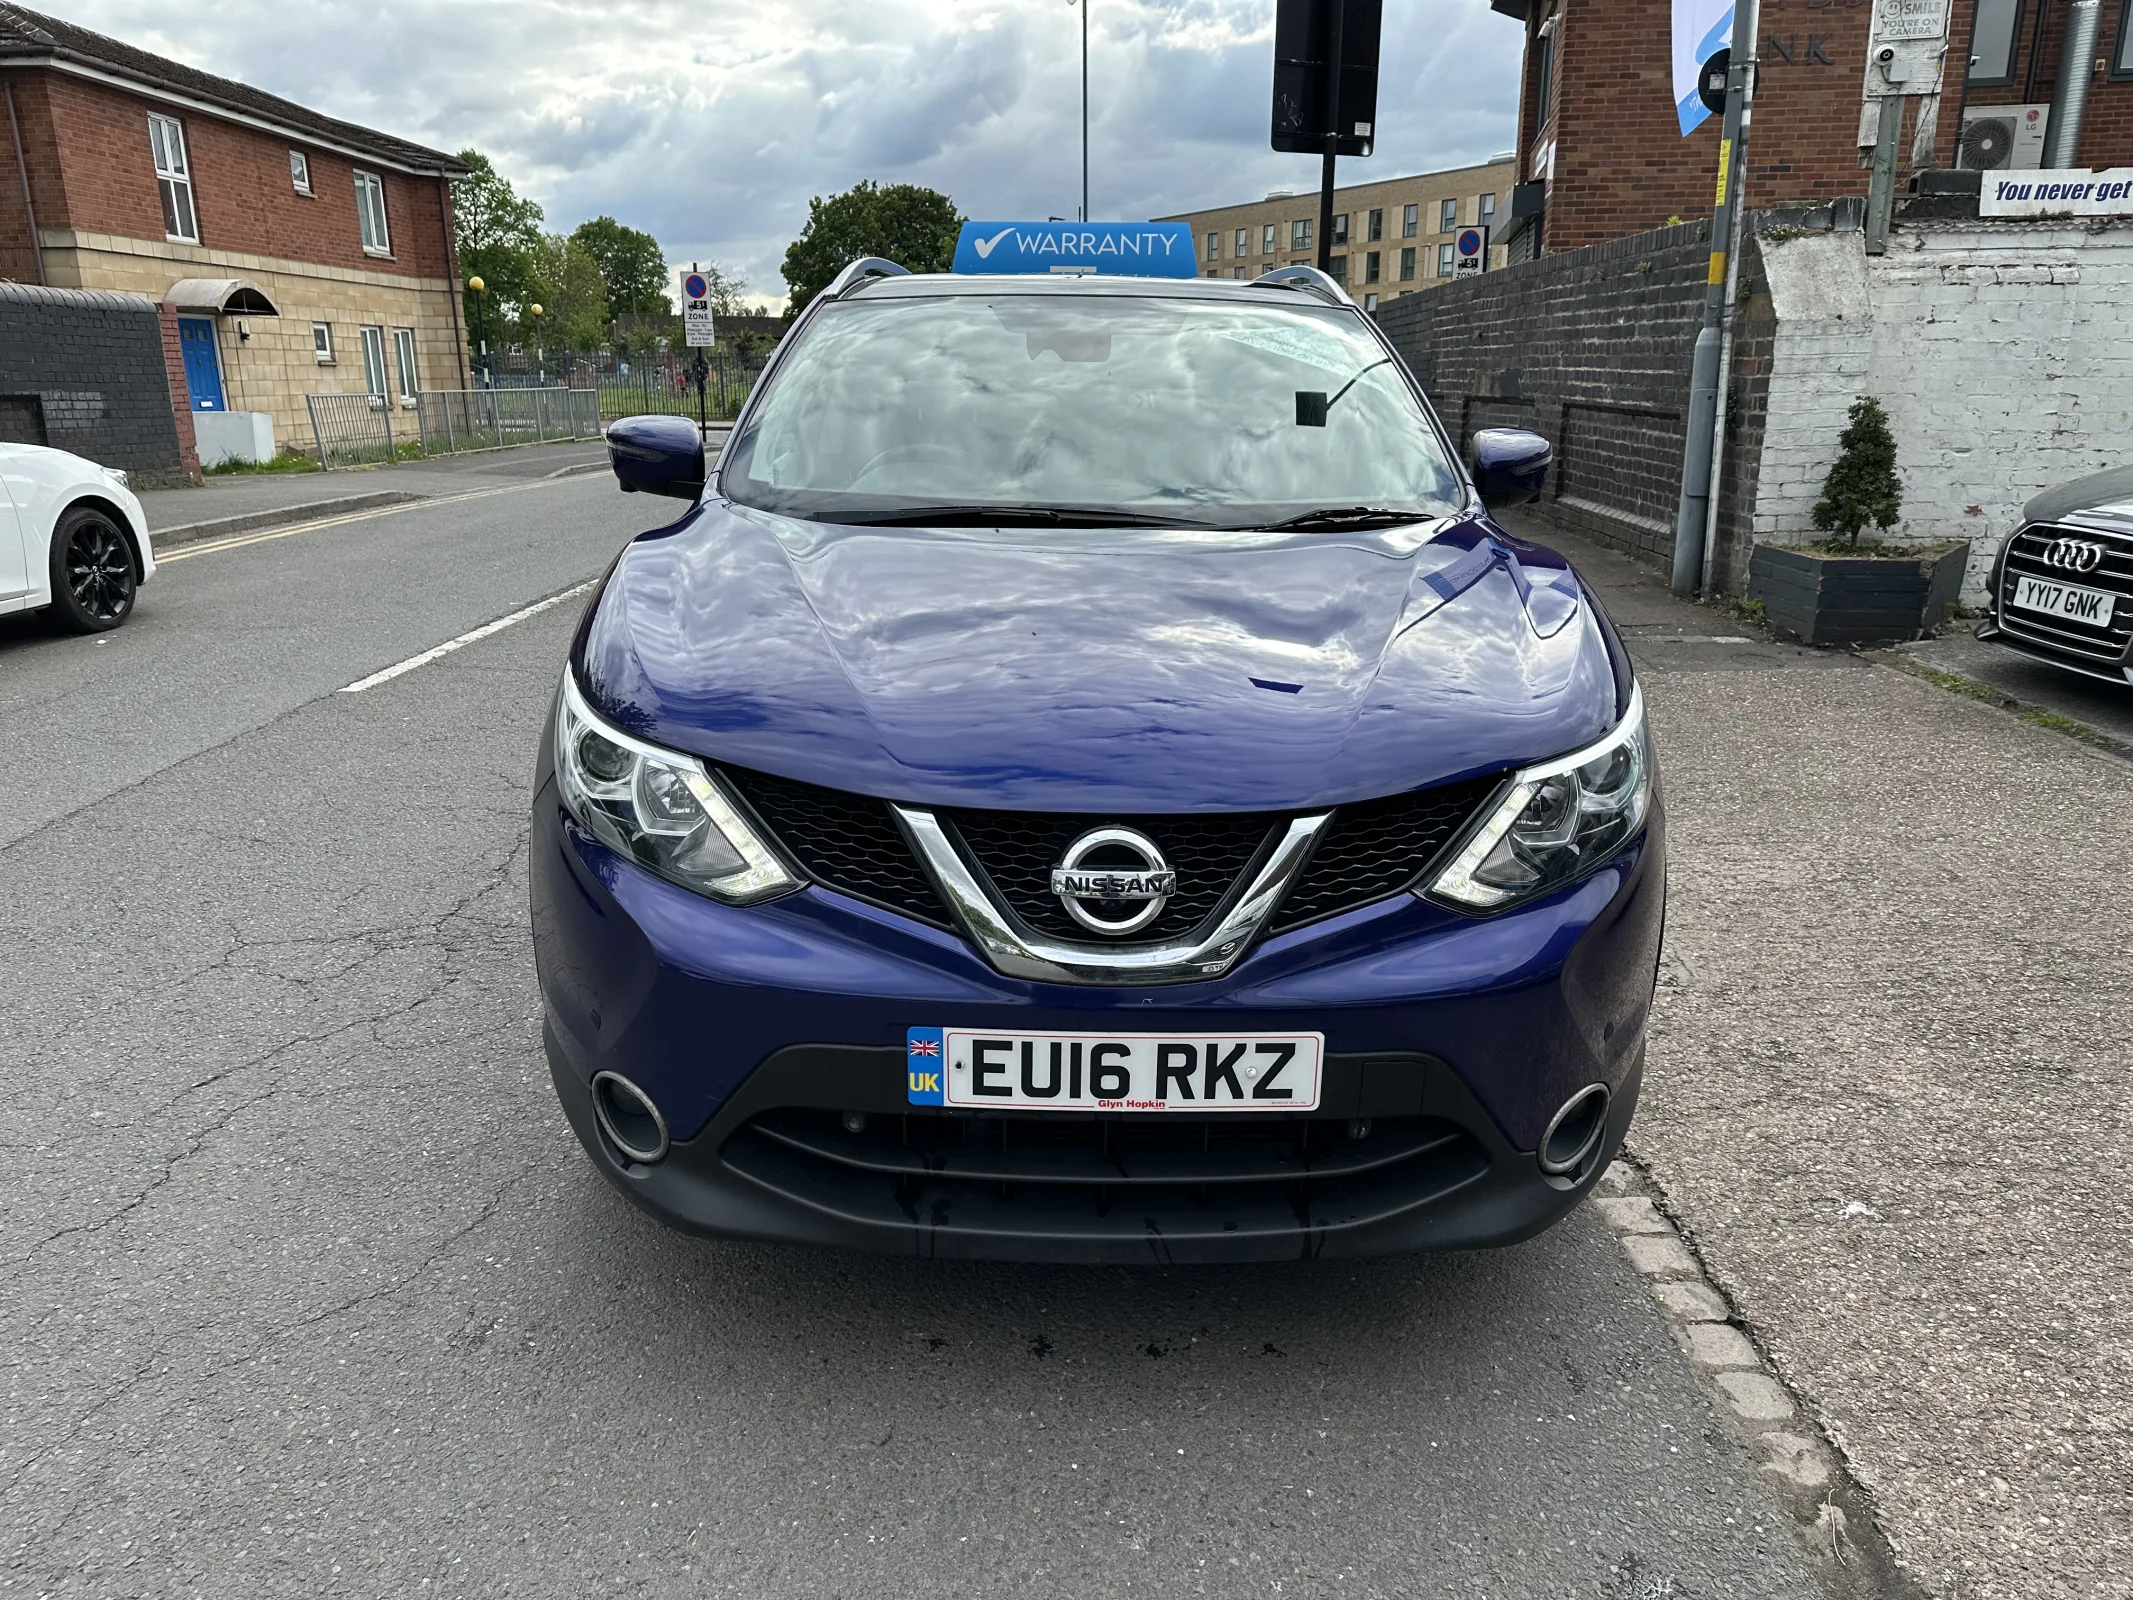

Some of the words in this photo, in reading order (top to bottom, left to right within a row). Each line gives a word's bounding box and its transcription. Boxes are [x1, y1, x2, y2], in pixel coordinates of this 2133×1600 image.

[1904, 2, 1941, 15] SMILE
[1882, 18, 1920, 28] YOU'RE
[1923, 17, 1940, 26] ON
[1889, 26, 1932, 36] CAMERA
[1767, 33, 1834, 66] NK
[2025, 123, 2037, 131] LG
[1996, 181, 2032, 201] You
[2033, 182, 2095, 201] never
[2095, 180, 2133, 202] get
[1015, 231, 1178, 256] WARRANTY
[2026, 581, 2063, 609] YY17
[2064, 590, 2104, 619] GNK
[1064, 875, 1163, 893] NISSAN
[972, 1039, 1131, 1099] EU16
[1155, 1042, 1297, 1100] RKZ
[909, 1072, 940, 1092] UK
[1098, 1100, 1123, 1109] Glyn
[1126, 1100, 1166, 1109] Hopkin
